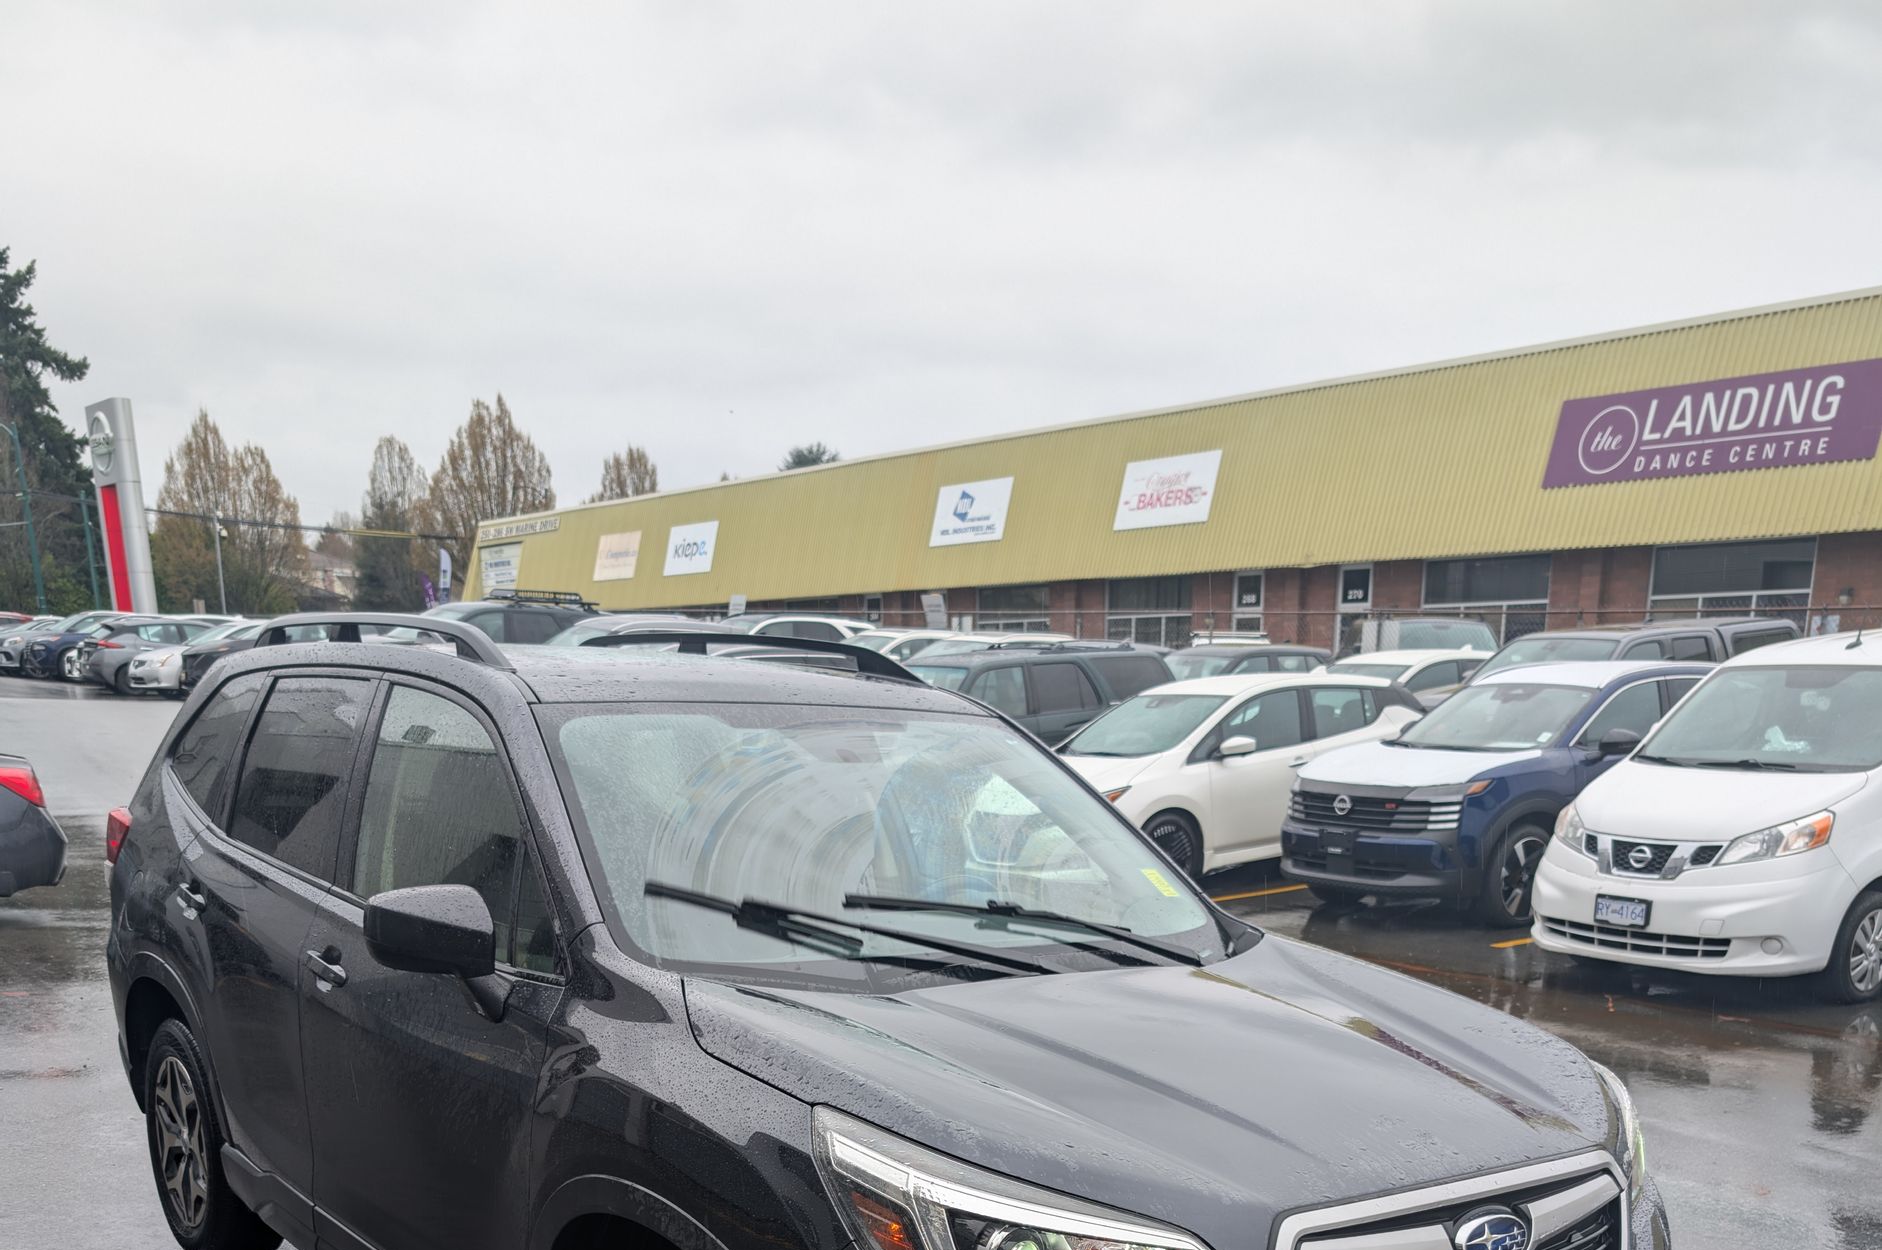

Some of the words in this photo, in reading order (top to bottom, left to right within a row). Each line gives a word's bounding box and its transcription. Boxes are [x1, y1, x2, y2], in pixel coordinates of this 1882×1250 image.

[1642, 376, 1844, 440] LANDING
[1590, 425, 1622, 452] the
[1633, 449, 1713, 472] DANCE
[1729, 437, 1830, 464] CENTRE
[1137, 489, 1194, 510] BAKERS
[516, 521, 538, 533] MARINE
[540, 517, 559, 530] DRIVE
